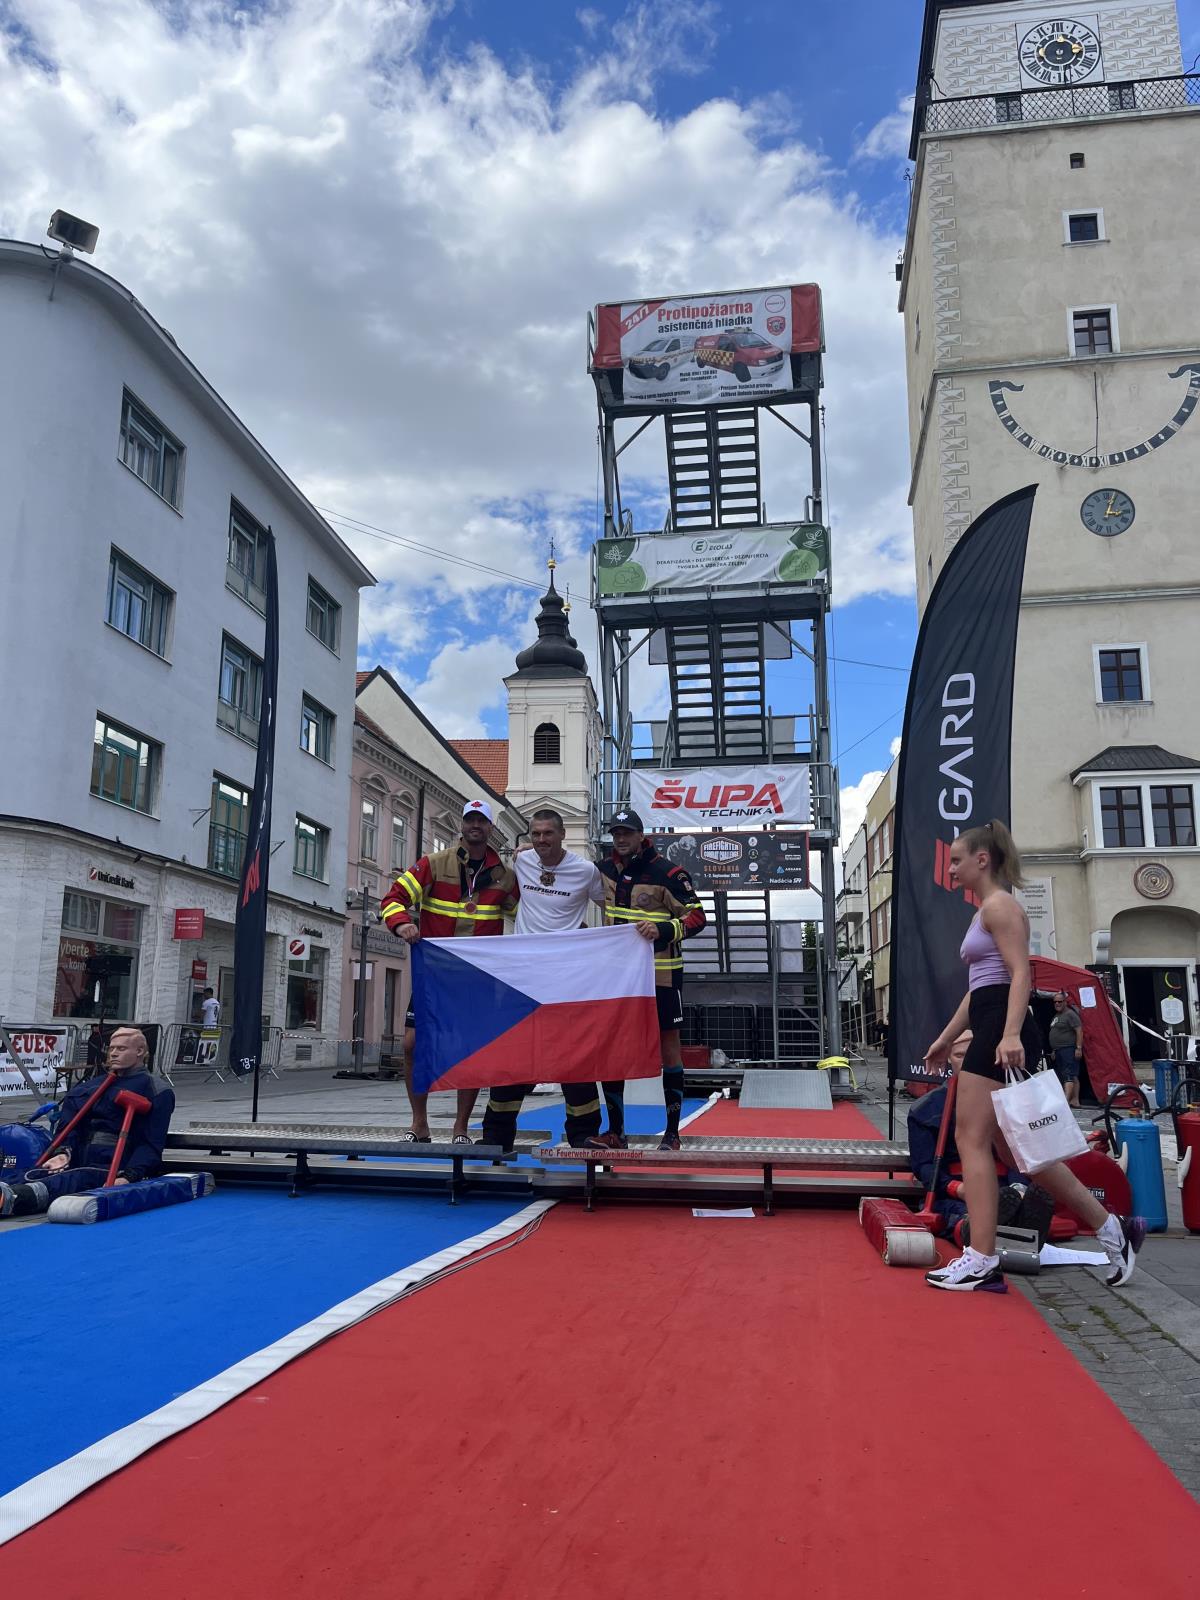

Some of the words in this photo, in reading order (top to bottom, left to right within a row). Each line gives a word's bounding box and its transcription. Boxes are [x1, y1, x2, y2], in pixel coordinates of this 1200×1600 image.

[658, 302, 753, 322] Protipožiarna
[658, 319, 713, 335] asistenčná
[715, 316, 753, 328] hliadka
[651, 779, 784, 813] ŠUPA
[700, 807, 773, 818] TECHNIKA
[704, 840, 739, 851] FIREFIGHTER
[523, 884, 571, 897] FIREFIGHTERS
[1028, 1114, 1058, 1130] BOZPO
[556, 1149, 590, 1158] Feuerwehr
